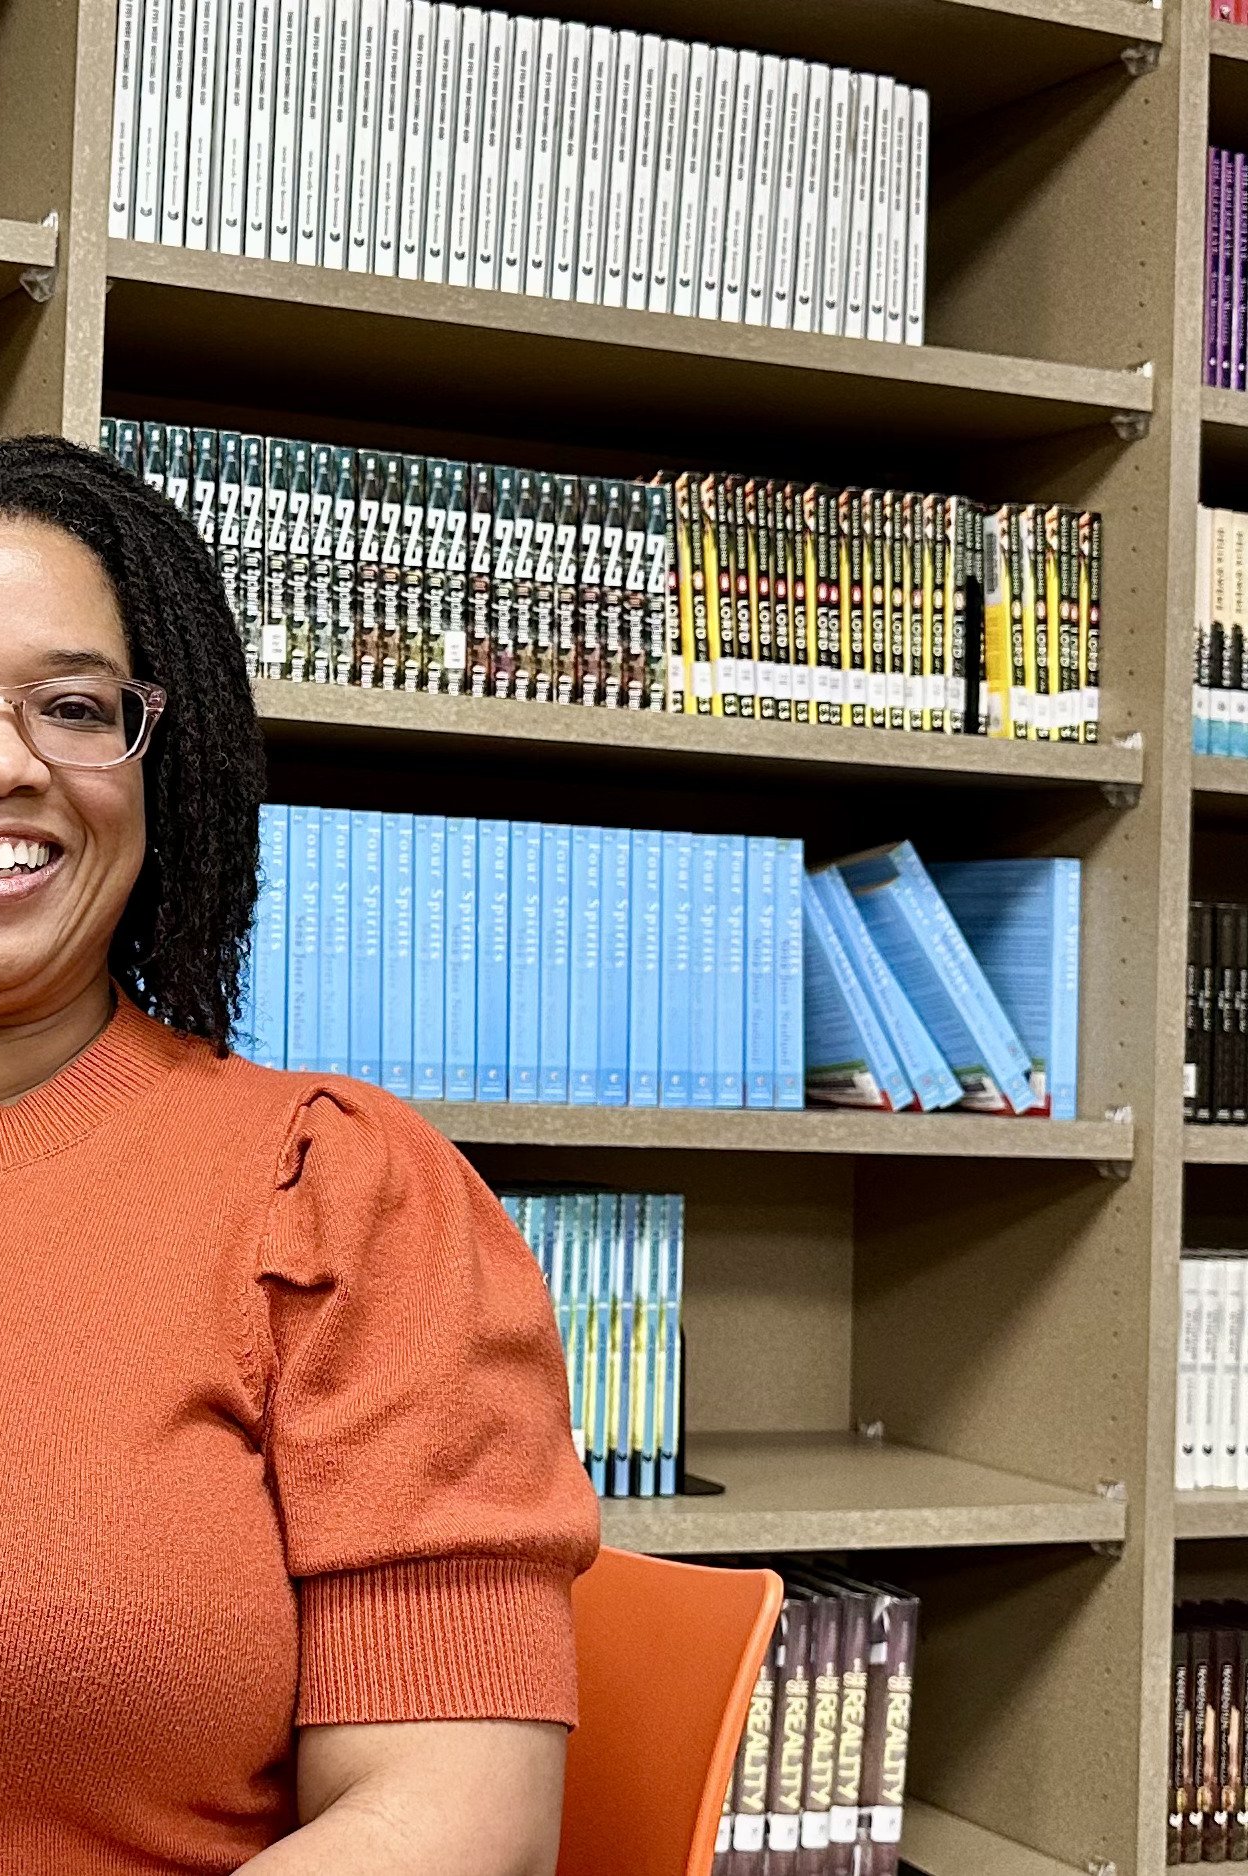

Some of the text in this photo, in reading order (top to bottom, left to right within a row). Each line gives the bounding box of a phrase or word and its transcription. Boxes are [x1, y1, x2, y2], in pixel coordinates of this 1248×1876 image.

[290, 492, 309, 554] Z
[335, 499, 355, 560] Z
[360, 500, 379, 561] Z
[472, 513, 491, 573] Z
[515, 518, 533, 578] Z
[557, 525, 576, 584] Z
[604, 527, 623, 586] Z
[694, 595, 707, 640] LORD
[721, 597, 733, 641] LORD
[738, 601, 750, 643] LORD
[776, 604, 788, 648] LORD
[852, 609, 863, 653] LORD
[873, 610, 885, 652] LORD
[933, 615, 943, 657] LORD
[1012, 624, 1023, 667] LORD
[1088, 629, 1099, 671] LORD
[302, 823, 319, 953] Four Spirits
[333, 823, 348, 953] Four Spirits
[363, 827, 381, 956] Four Spirits
[396, 828, 412, 957] Four Spirits
[459, 834, 475, 962] Four Spirits
[491, 835, 507, 962] Four Spirits
[613, 844, 630, 969] Four Spirits
[743, 1697, 772, 1811] REALITY
[780, 1697, 808, 1810] REALITY
[810, 1693, 838, 1805] REALITY
[837, 1689, 866, 1801] REALITY
[882, 1692, 911, 1803] REALITY
